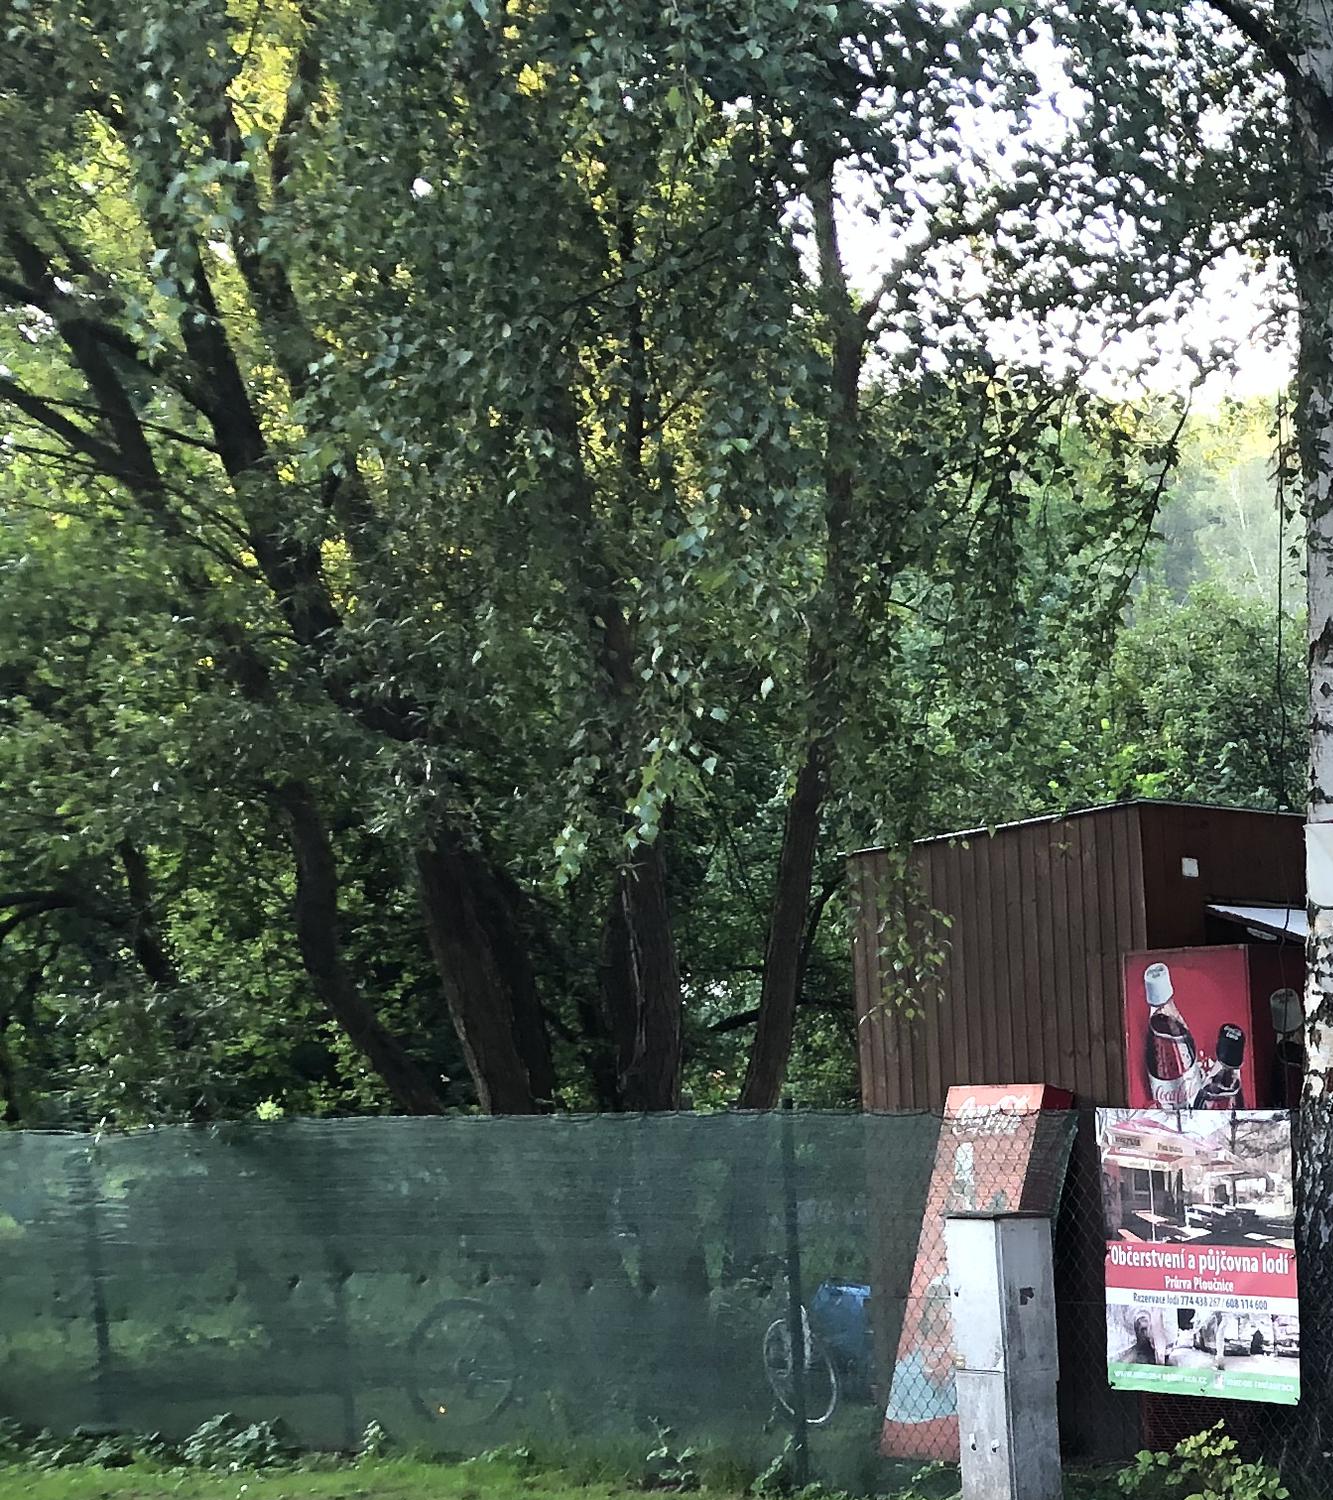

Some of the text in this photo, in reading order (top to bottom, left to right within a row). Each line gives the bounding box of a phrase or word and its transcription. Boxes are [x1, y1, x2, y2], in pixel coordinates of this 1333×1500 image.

[1110, 1245, 1289, 1276] Občerstvení a půjčovna lodí
